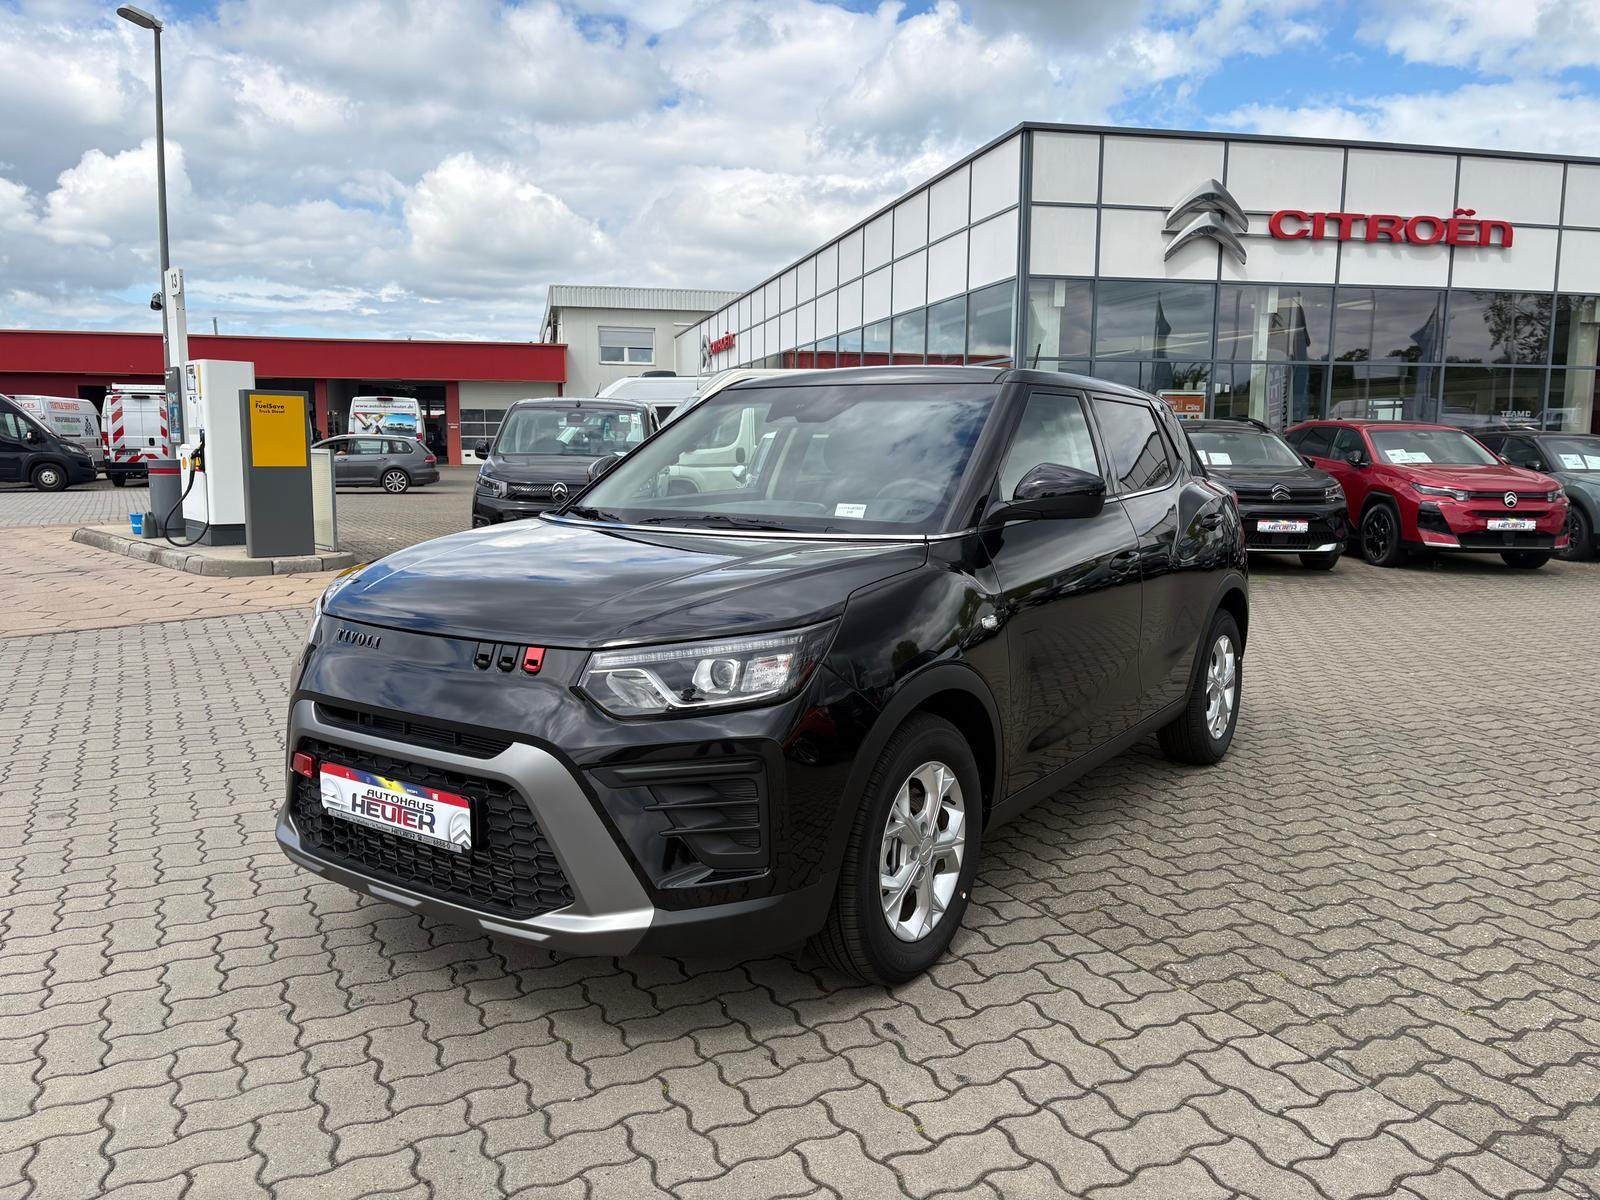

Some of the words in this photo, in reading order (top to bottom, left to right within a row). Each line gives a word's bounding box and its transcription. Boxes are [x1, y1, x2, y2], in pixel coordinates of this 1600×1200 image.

[1268, 208, 1513, 248] CITROËN
[170, 273, 178, 289] 13
[255, 402, 285, 410] FuelSave
[336, 628, 381, 649] TIVOLI
[366, 789, 434, 812] AUTOHAUS
[351, 793, 436, 834] HEUTER
